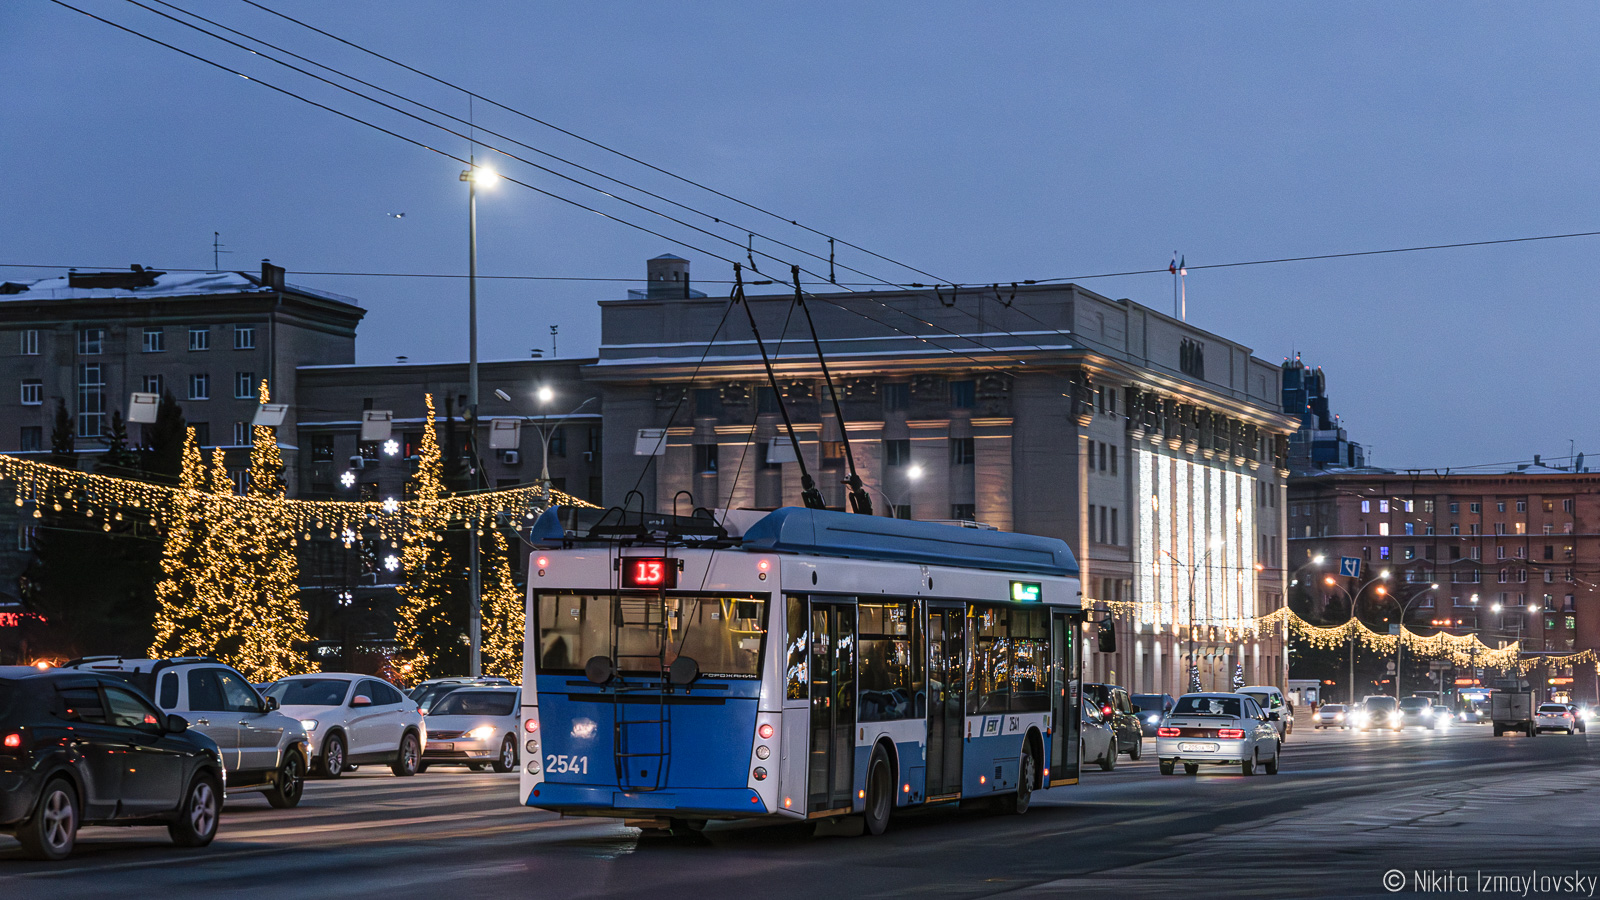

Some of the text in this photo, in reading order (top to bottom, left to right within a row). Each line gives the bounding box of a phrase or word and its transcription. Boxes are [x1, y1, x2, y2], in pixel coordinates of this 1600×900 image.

[636, 563, 661, 582] 13
[1009, 716, 1020, 732] 2541
[546, 754, 588, 775] 2541
